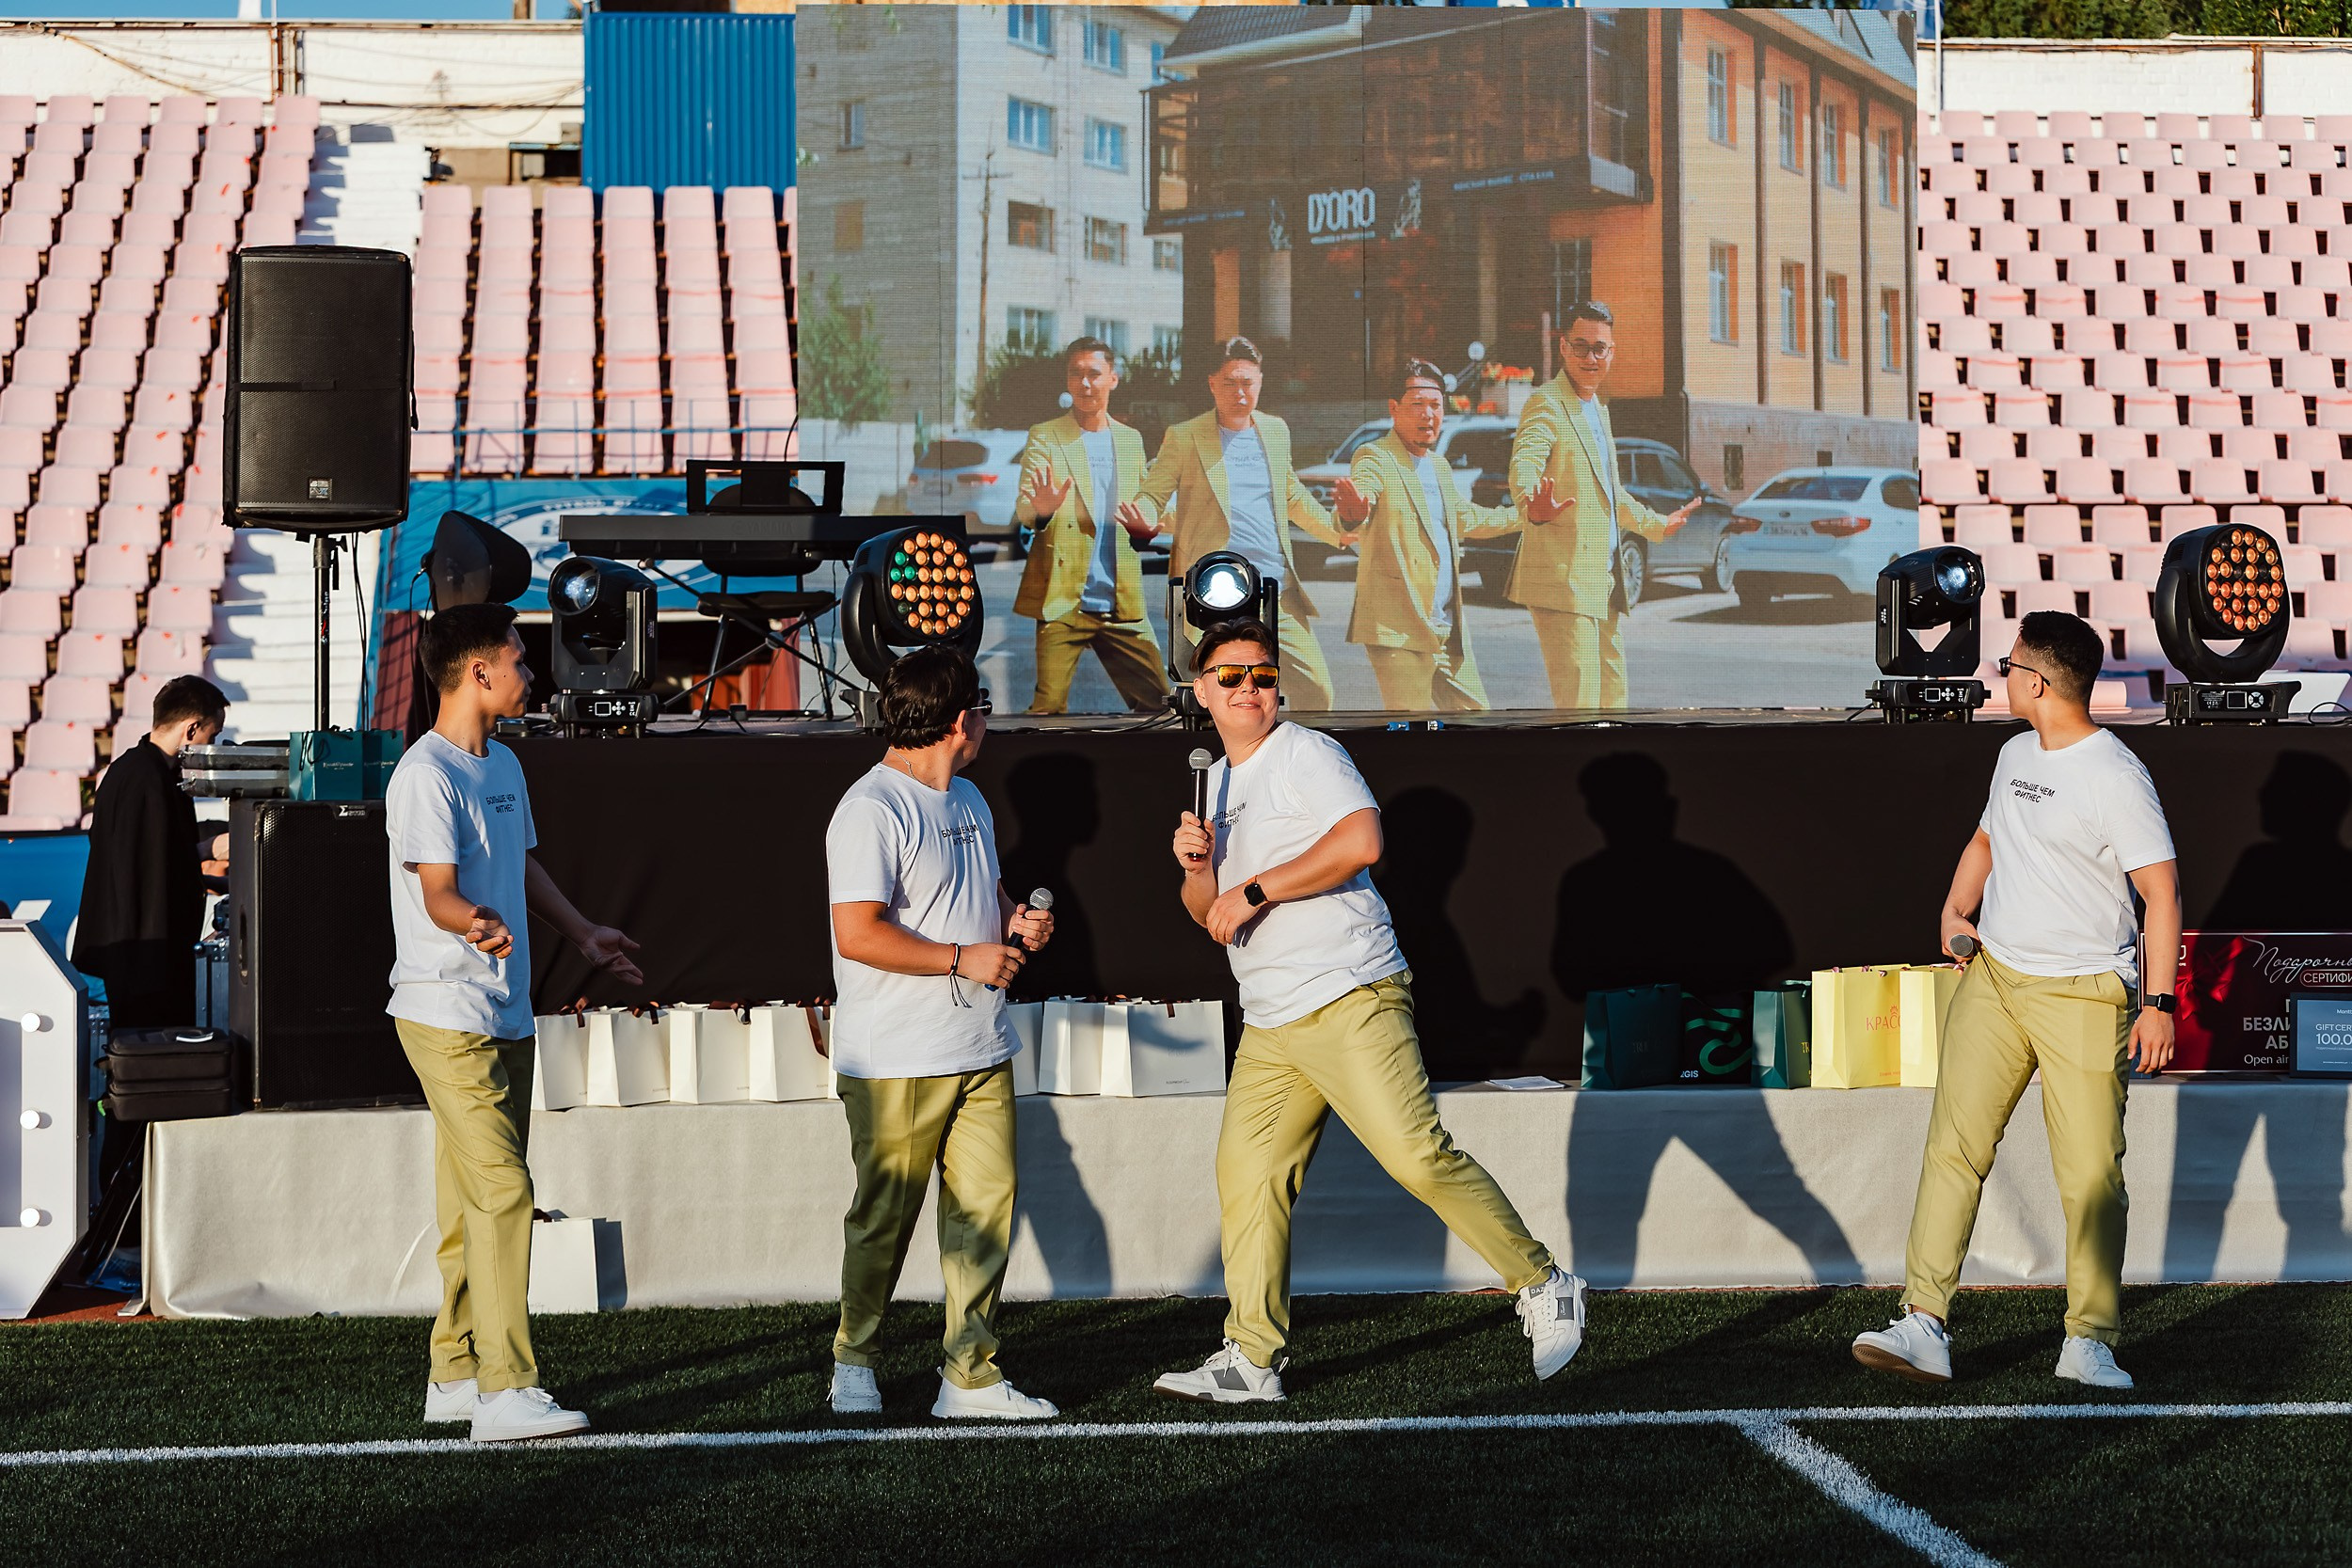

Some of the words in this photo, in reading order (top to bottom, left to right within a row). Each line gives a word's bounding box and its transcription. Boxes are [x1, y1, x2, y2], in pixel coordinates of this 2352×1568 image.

[2010, 779, 2040, 793] БОЛЬШЕ
[2040, 785, 2056, 798] ЧЕМ
[2014, 789, 2042, 803] ФИТНЕС
[2244, 1053, 2274, 1067] Open
[2276, 1054, 2290, 1064] air
